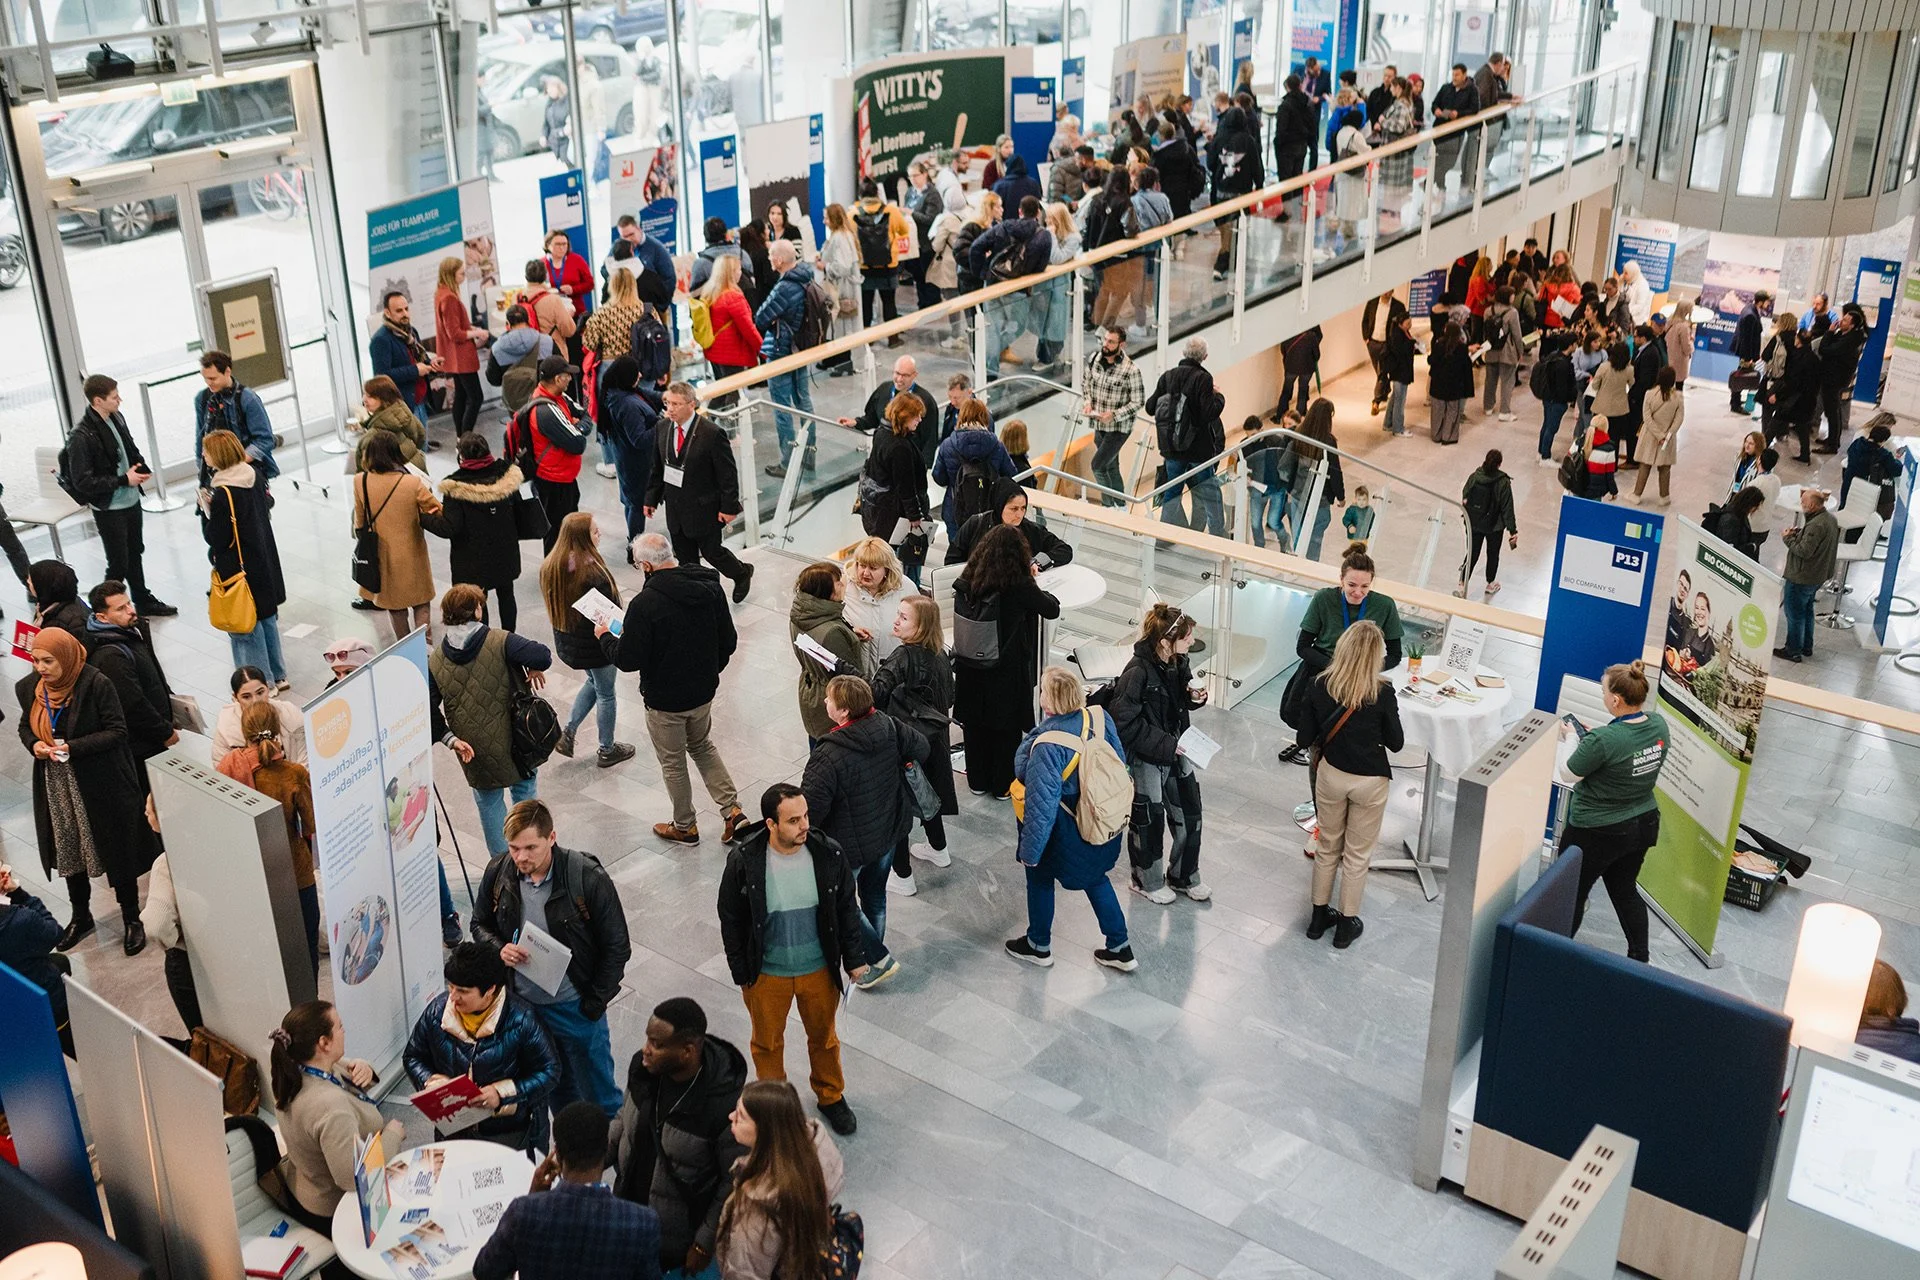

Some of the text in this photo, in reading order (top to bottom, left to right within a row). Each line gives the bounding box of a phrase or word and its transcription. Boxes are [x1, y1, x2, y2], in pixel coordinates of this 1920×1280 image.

[873, 69, 944, 111] WITTY'S
[882, 131, 925, 154] Berliner
[371, 223, 388, 237] JOBS
[401, 208, 440, 228] TEAMPLAYER
[1615, 552, 1640, 567] P13
[1704, 551, 1716, 565] BIO
[1715, 560, 1748, 586] COMPANY
[1563, 575, 1616, 594] BIO COMPANY SE
